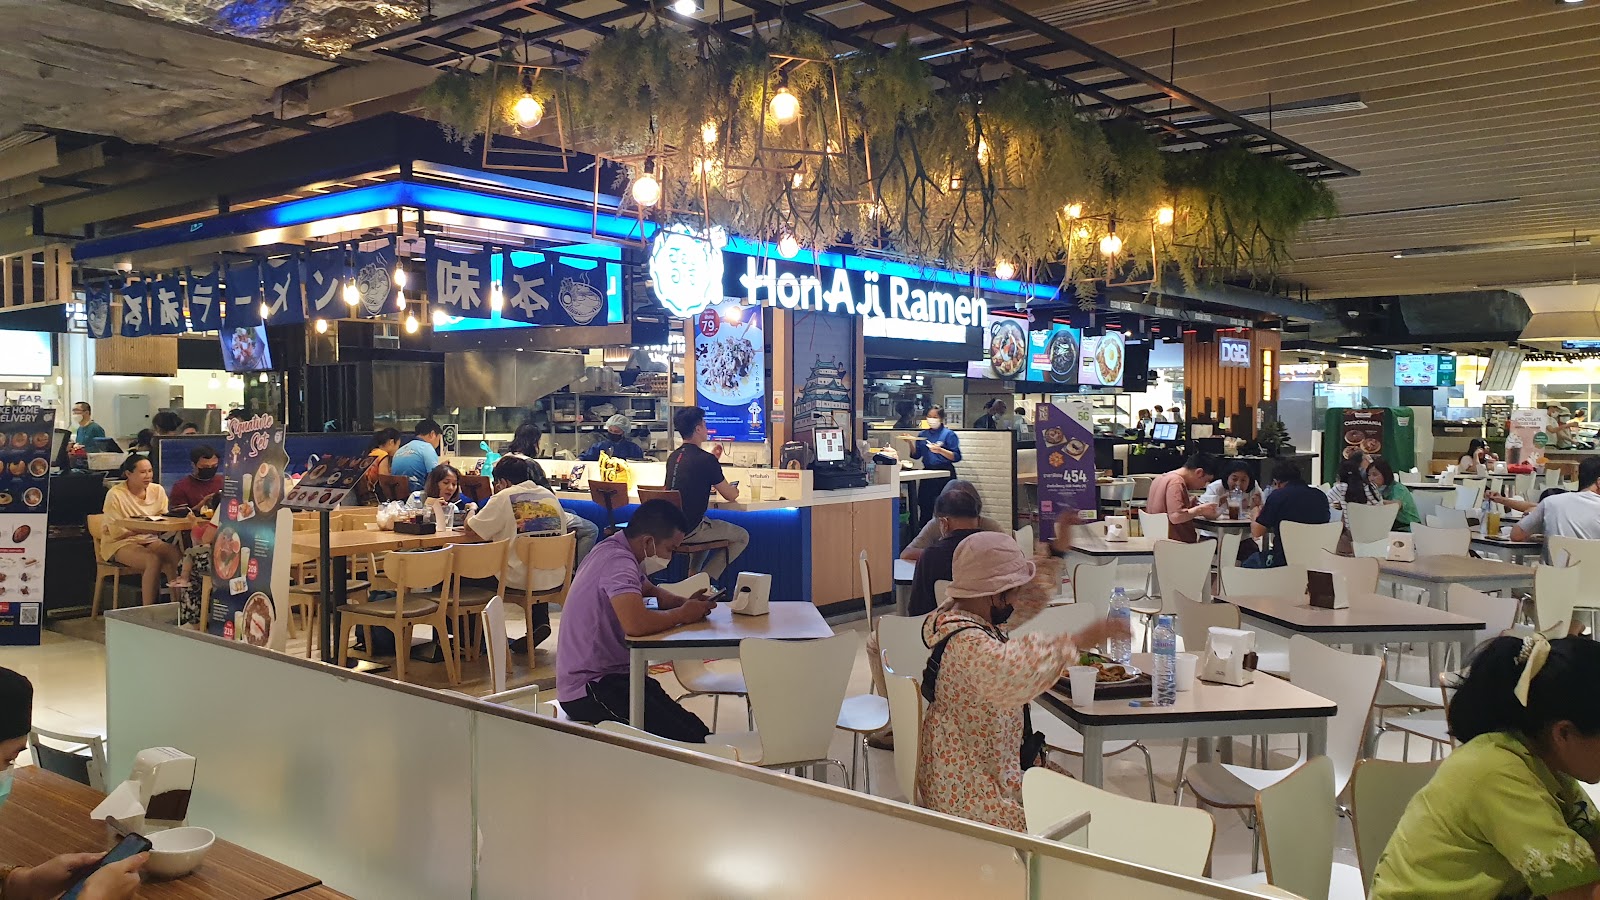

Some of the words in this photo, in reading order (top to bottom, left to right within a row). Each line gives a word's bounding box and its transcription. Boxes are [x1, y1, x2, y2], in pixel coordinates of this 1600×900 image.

[889, 275, 989, 328] Ramen
[12, 406, 40, 414] HOME
[1077, 411, 1090, 421] 5G
[226, 413, 274, 441] Signature
[249, 431, 270, 457] Set
